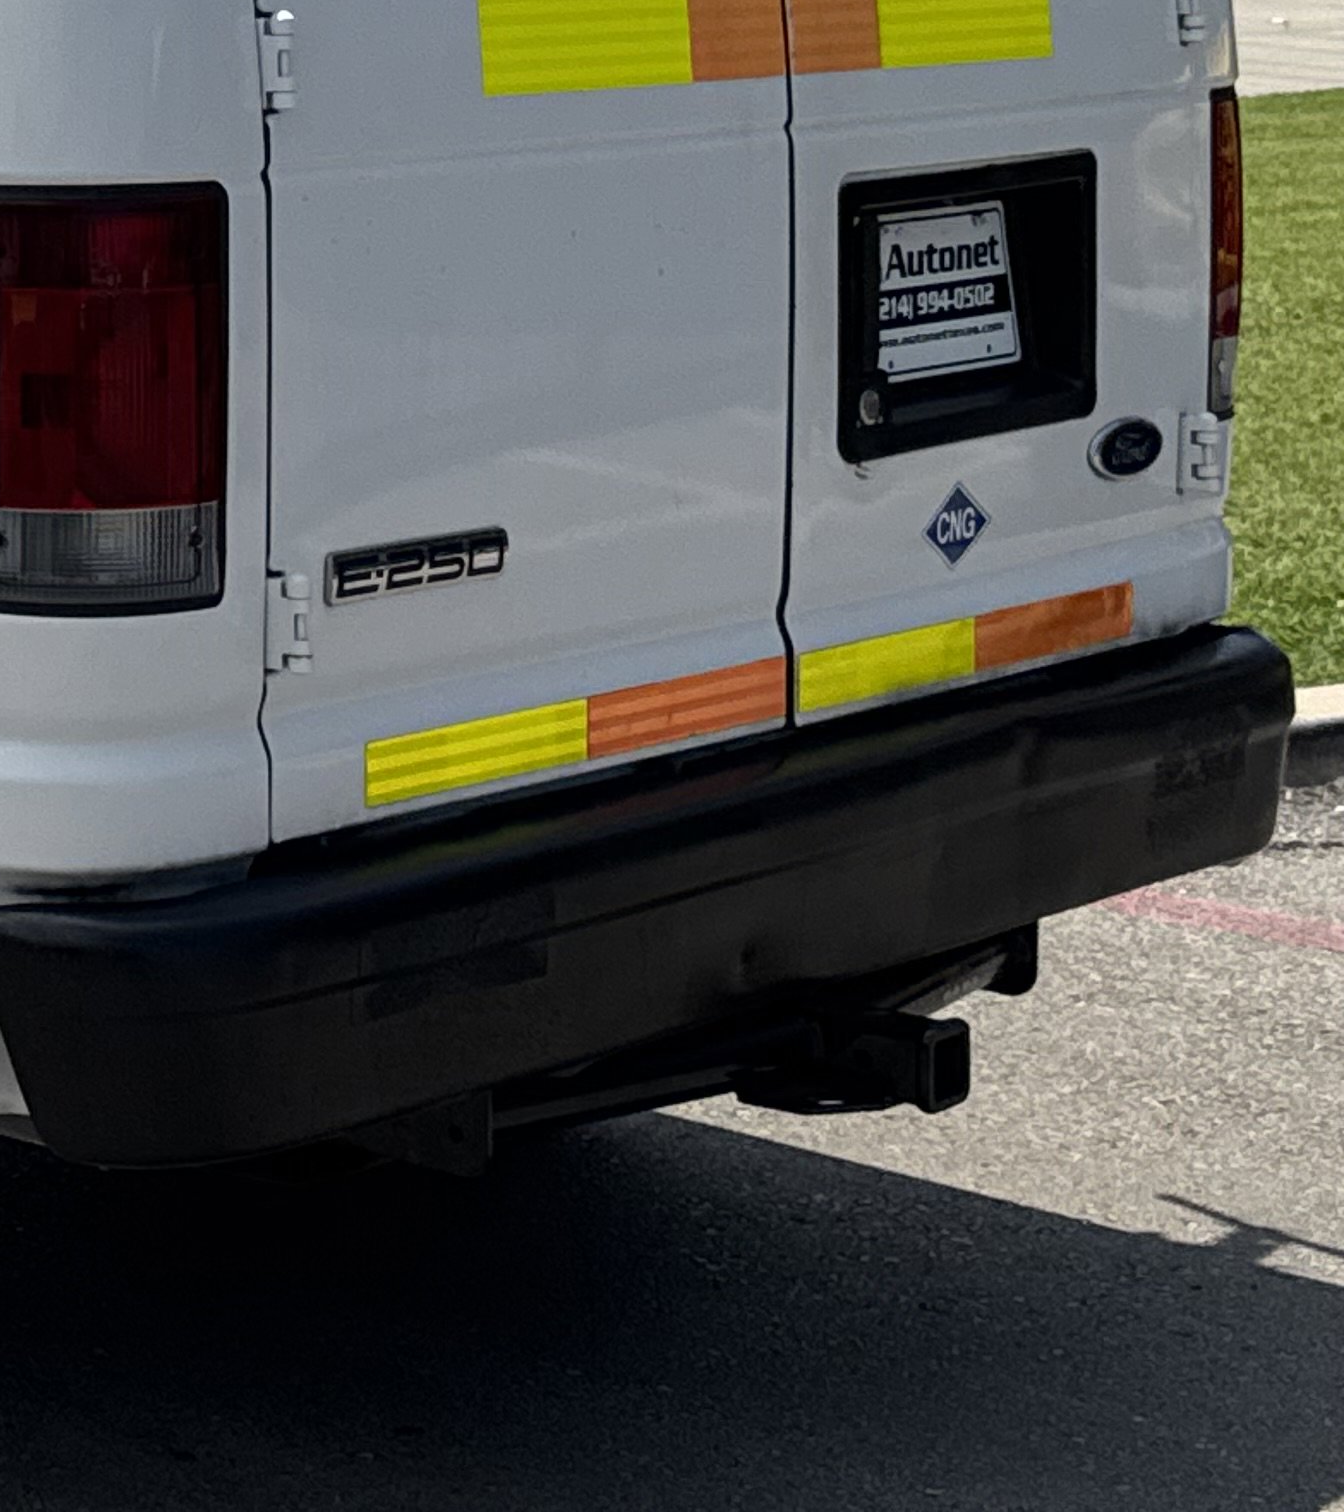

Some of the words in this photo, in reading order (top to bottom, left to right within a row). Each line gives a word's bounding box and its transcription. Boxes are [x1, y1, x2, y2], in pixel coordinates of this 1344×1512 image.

[885, 235, 1000, 281] Autonet
[879, 292, 913, 321] 214)
[917, 283, 995, 316] 994-0502
[936, 506, 976, 545] CNG
[334, 533, 505, 599] E-250
